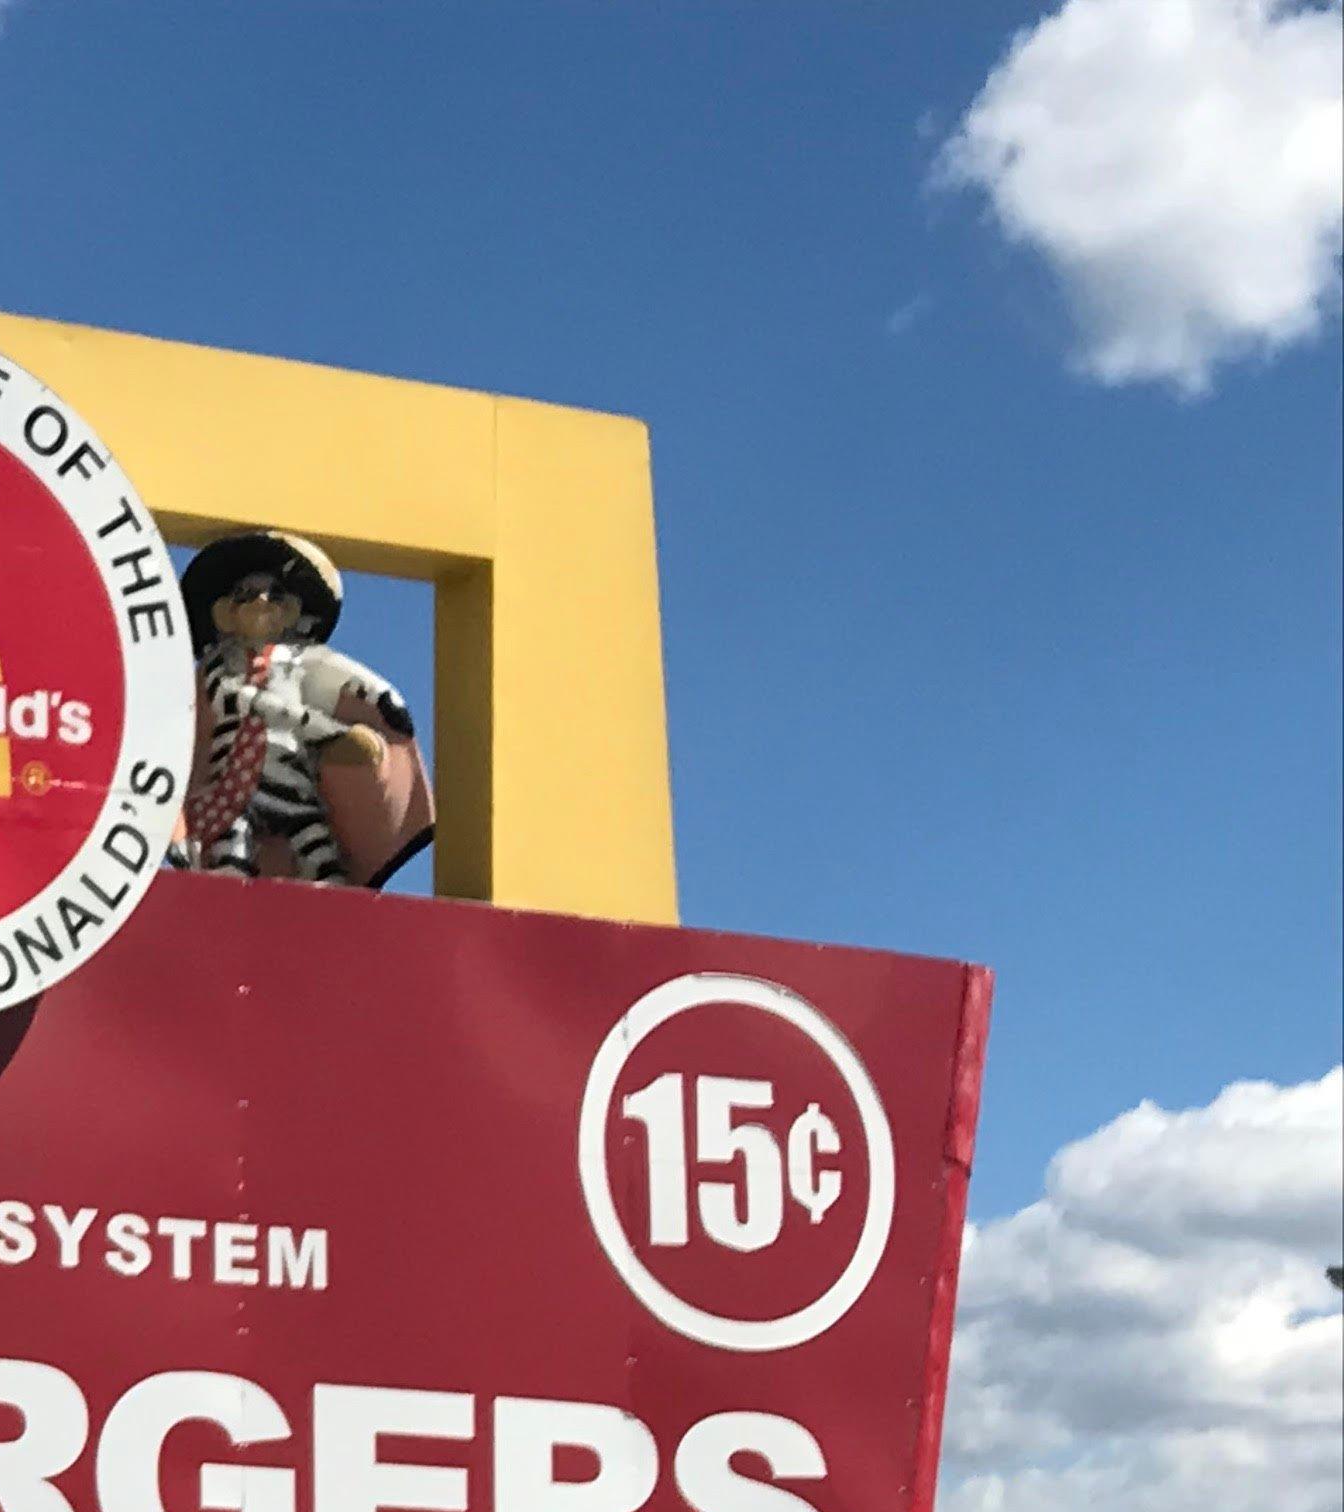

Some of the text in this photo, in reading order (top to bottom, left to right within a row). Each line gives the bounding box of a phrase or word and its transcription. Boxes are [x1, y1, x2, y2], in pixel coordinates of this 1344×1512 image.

[23, 405, 107, 485] OF
[97, 497, 174, 643] THE
[622, 1072, 842, 1253] 15¢
